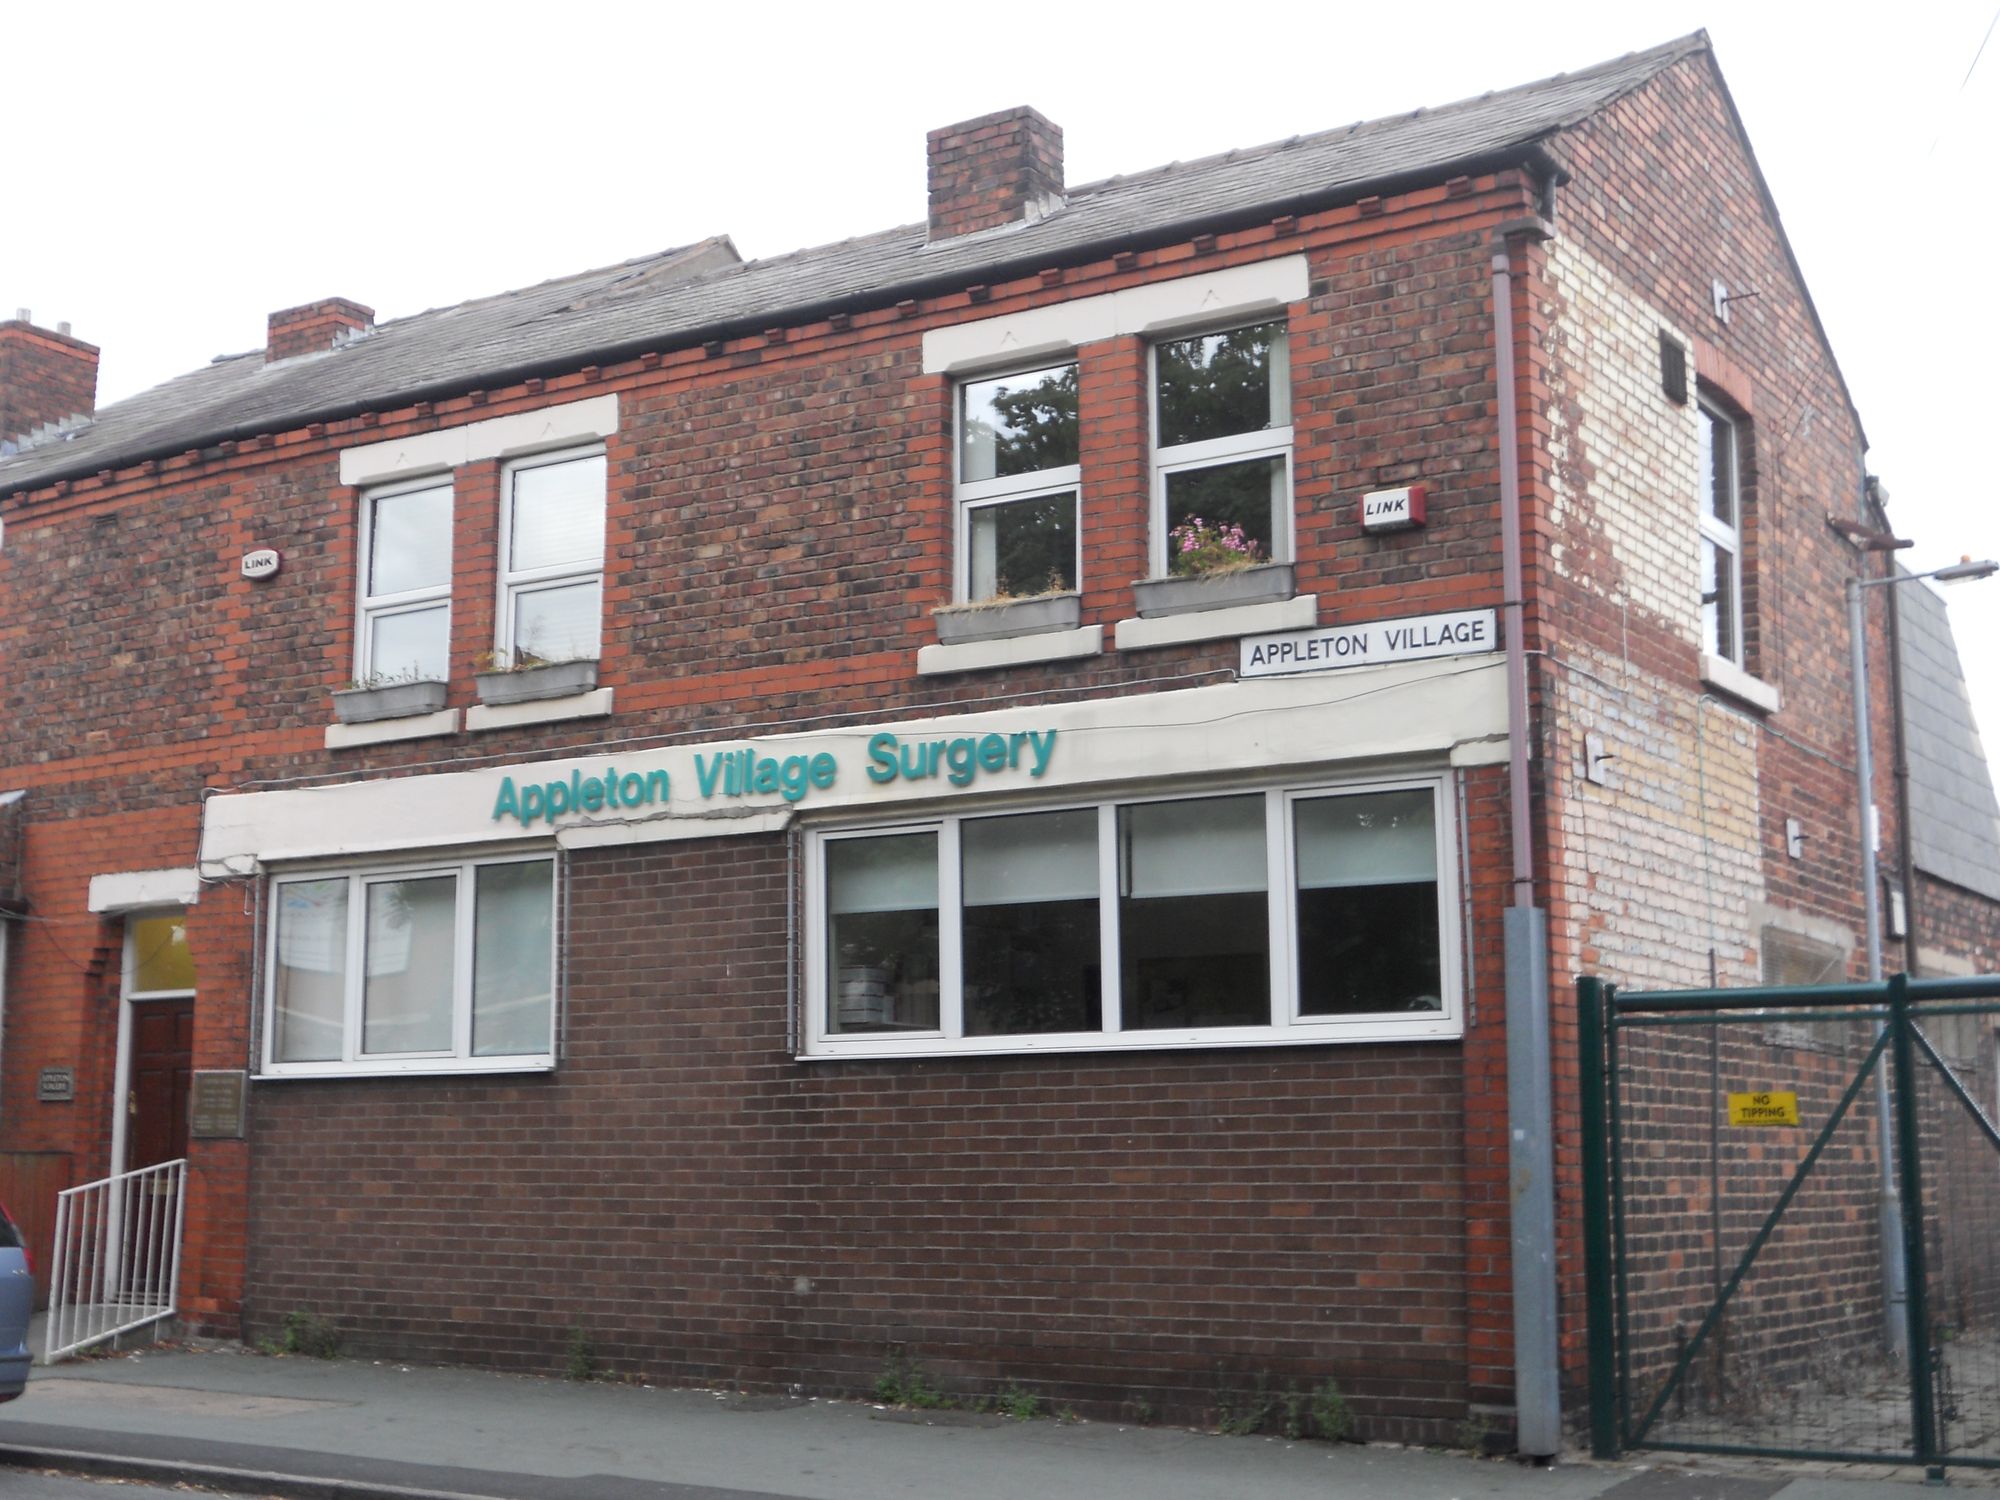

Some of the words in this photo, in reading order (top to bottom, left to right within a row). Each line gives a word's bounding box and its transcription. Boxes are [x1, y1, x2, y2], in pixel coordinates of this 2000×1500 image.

[1366, 499, 1405, 515] LINK
[245, 557, 272, 569] LINK
[1250, 633, 1368, 666] APPLETON
[1385, 620, 1485, 651] VILLAGE
[492, 768, 670, 827] Appleton
[694, 747, 837, 801] Village
[866, 728, 1058, 787] Surgery
[1753, 1095, 1770, 1106] NO
[1742, 1107, 1785, 1118] TIPPING
